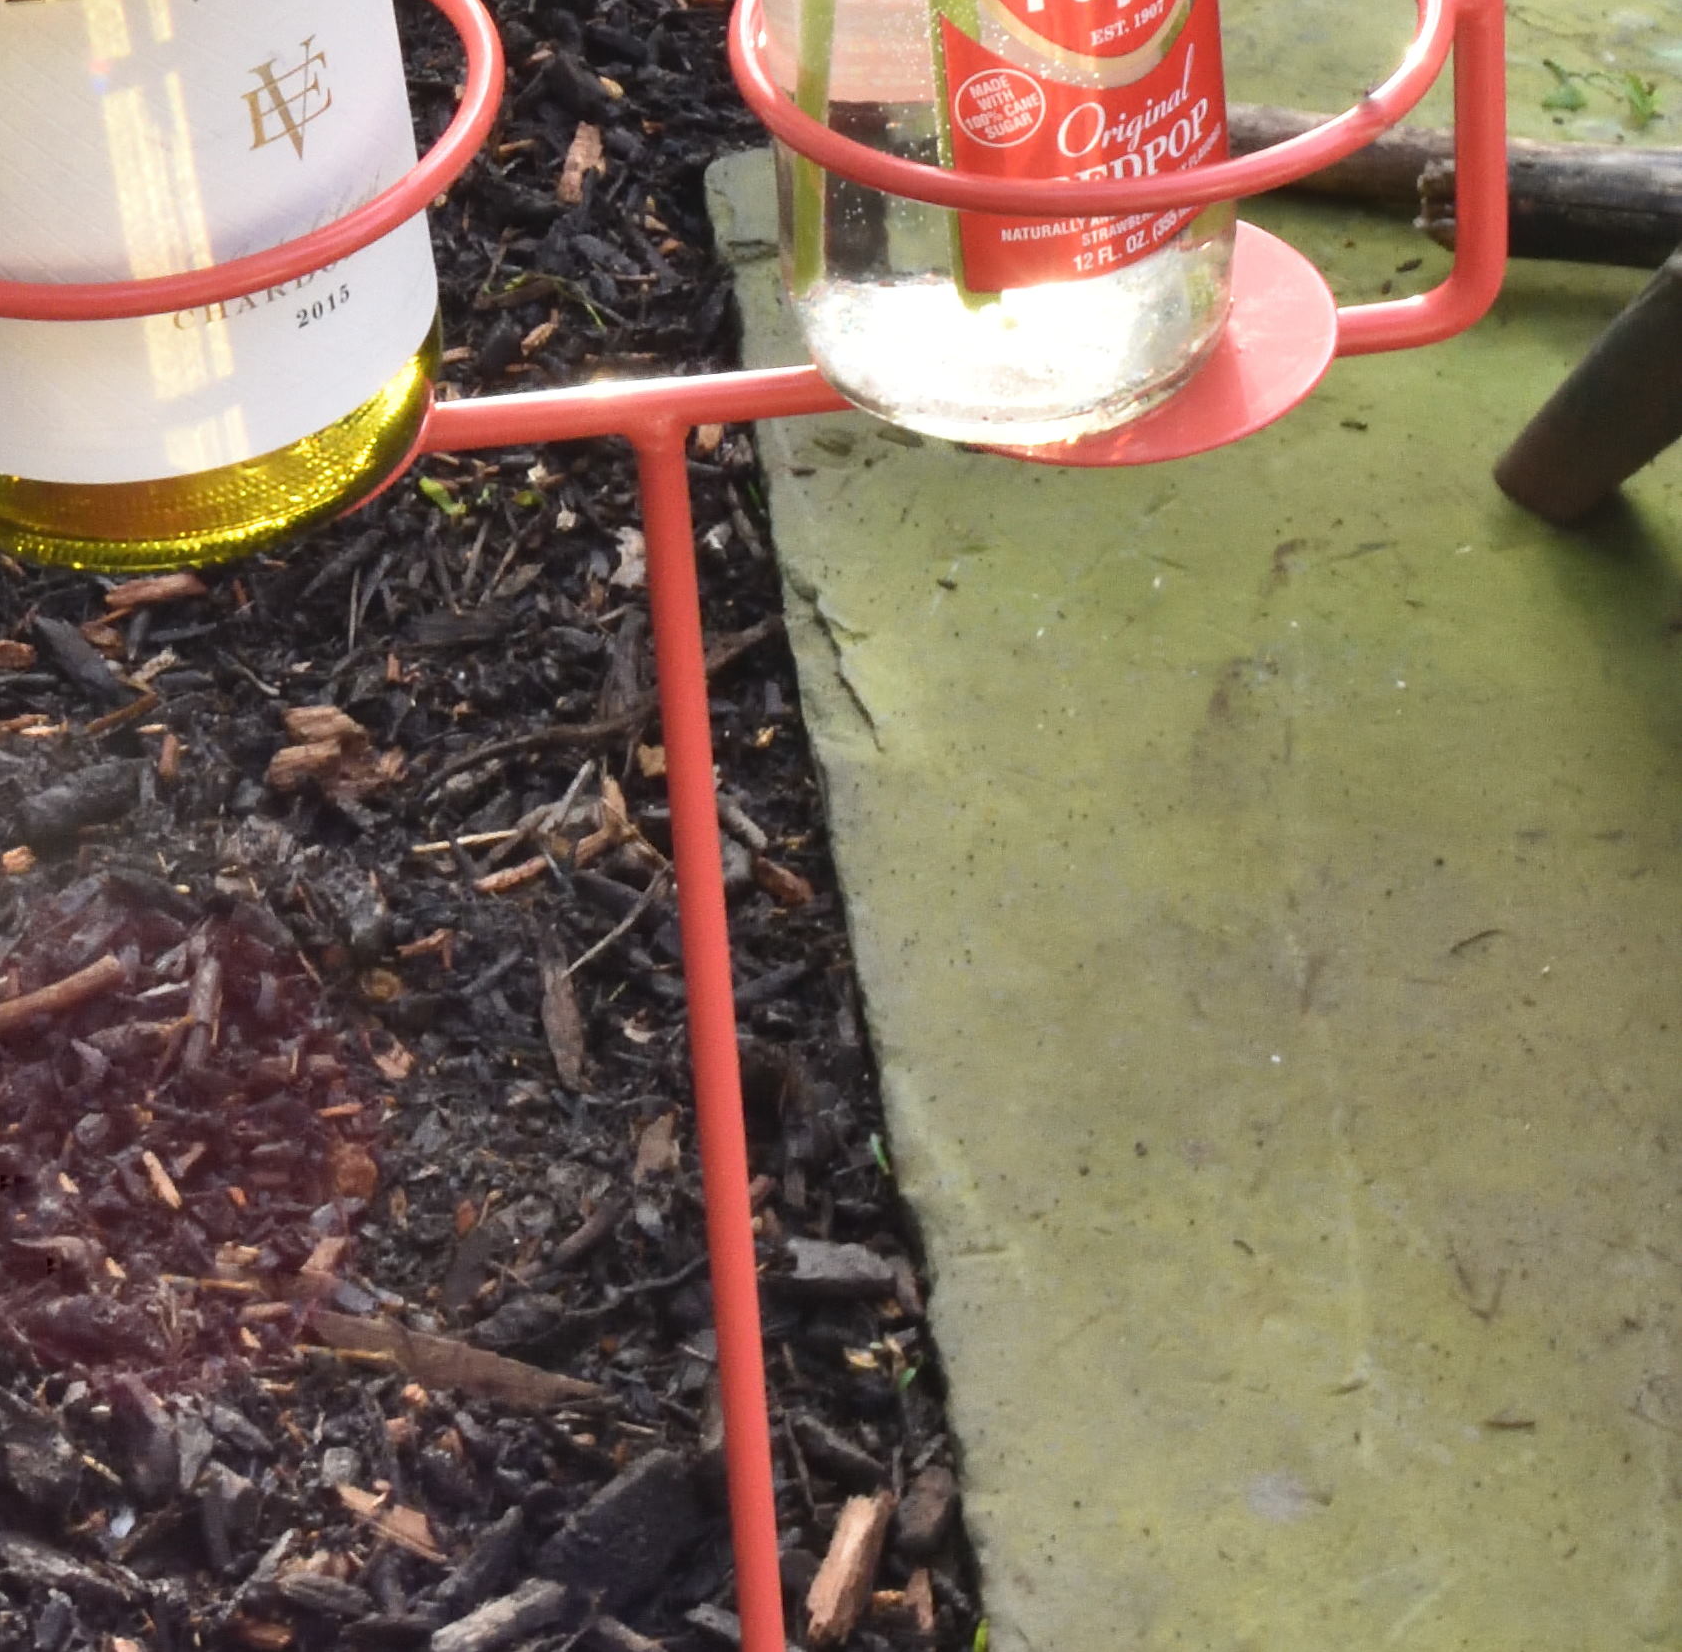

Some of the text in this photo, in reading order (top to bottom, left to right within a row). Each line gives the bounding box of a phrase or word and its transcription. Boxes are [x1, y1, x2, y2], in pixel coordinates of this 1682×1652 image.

[1090, 19, 1129, 47] EST.
[969, 74, 1010, 98] MADE
[976, 88, 1015, 111] WITH
[965, 92, 1040, 130] 100% CANE
[1057, 43, 1194, 158] Original
[984, 112, 1033, 140] SUGAR
[1001, 216, 1086, 241] NATURALLY
[1073, 252, 1094, 272] 12
[1098, 245, 1122, 266] FL.
[1126, 229, 1150, 254] OZ.
[296, 283, 350, 329] 2015
